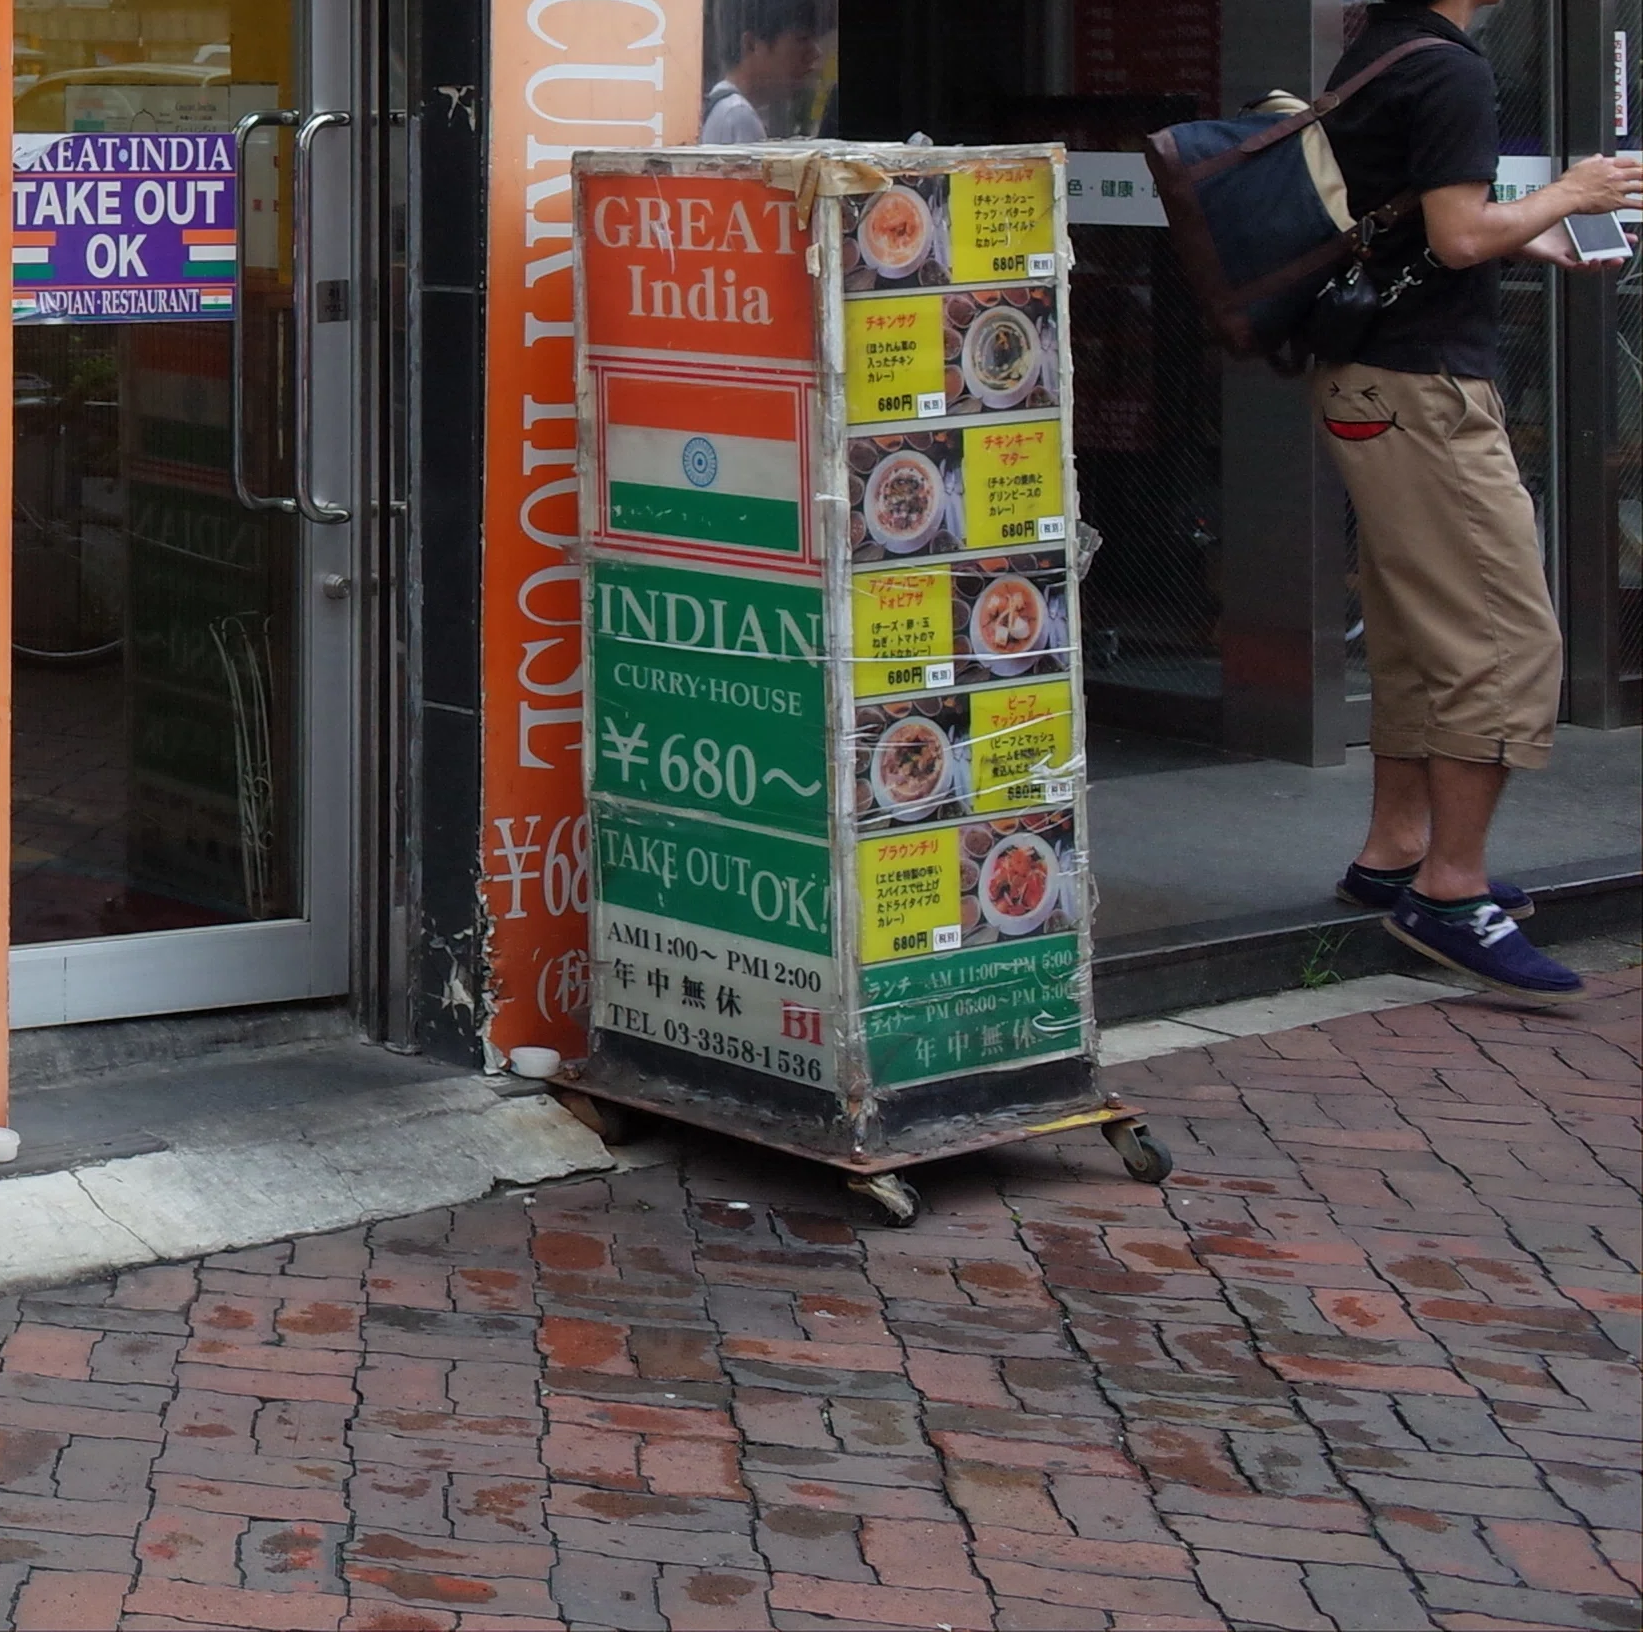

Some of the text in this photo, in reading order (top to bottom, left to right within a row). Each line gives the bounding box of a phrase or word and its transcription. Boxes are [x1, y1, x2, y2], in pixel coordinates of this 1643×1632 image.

[13, 137, 233, 172] REAT·INDIA
[12, 180, 224, 225] TAKE OUT
[594, 195, 800, 256] GREAT
[86, 233, 148, 278] OK
[993, 256, 1025, 271] 680円
[627, 264, 775, 326] India
[866, 312, 916, 331] チキンサグ
[878, 395, 912, 412] 680円
[1002, 520, 1034, 537] 680円
[597, 582, 821, 668] INDIAN
[888, 667, 922, 685] 680円
[603, 827, 677, 880] TAKE
[685, 847, 750, 896] OUT
[893, 932, 927, 951] 680円
[612, 957, 743, 1018] 年中無休
[727, 950, 821, 992] PM12:00
[608, 1002, 821, 1082] TEL 03-3358-1536
